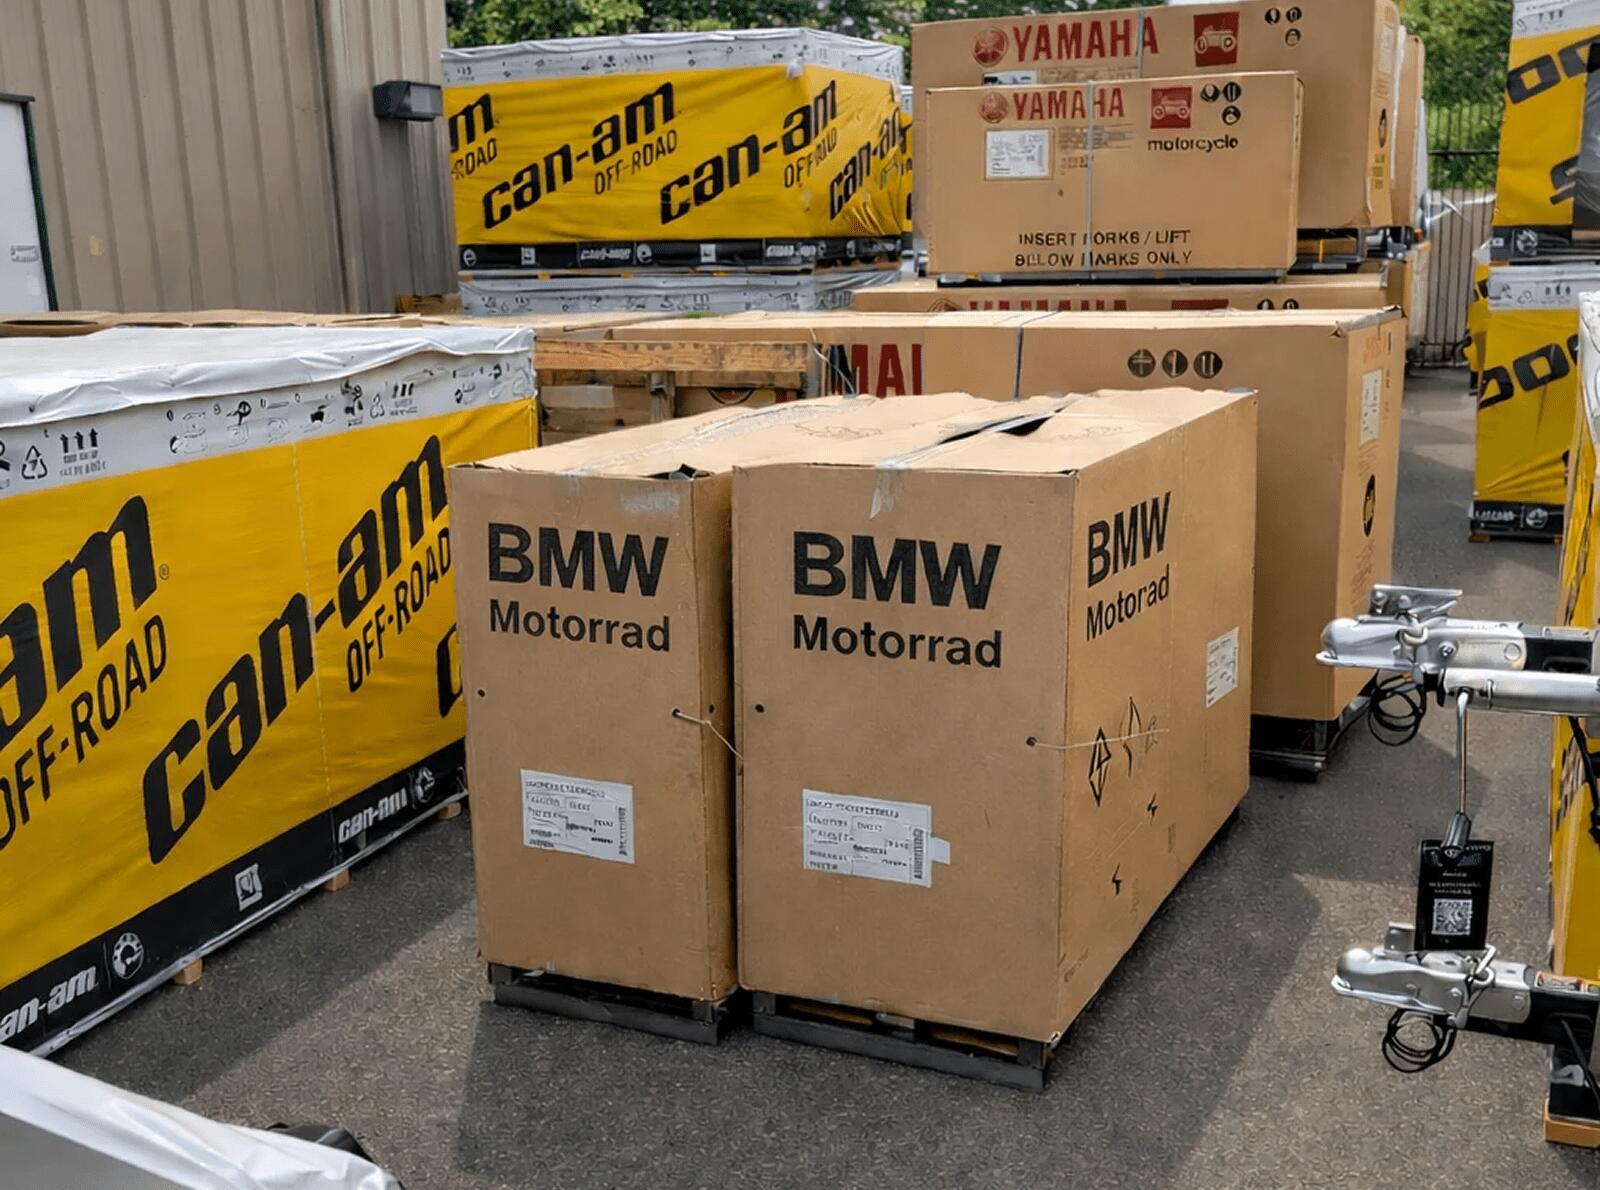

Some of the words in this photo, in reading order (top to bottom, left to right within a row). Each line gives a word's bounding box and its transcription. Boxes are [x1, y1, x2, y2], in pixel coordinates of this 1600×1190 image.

[1013, 16, 1160, 63] YAMAHA
[1013, 87, 1126, 121] YAMAHA
[482, 81, 675, 230] can-am
[594, 129, 678, 195] OFF-ROAD
[659, 79, 837, 226] can-am
[1018, 232, 1077, 247] INSERT
[488, 522, 670, 597] BMW
[793, 530, 1002, 611] BMW
[1087, 491, 1172, 589] BMW
[346, 526, 451, 694] OFF-ROAD
[489, 598, 671, 652] Motorrad
[793, 613, 1002, 668] Motorrad
[142, 434, 449, 865] can-am
